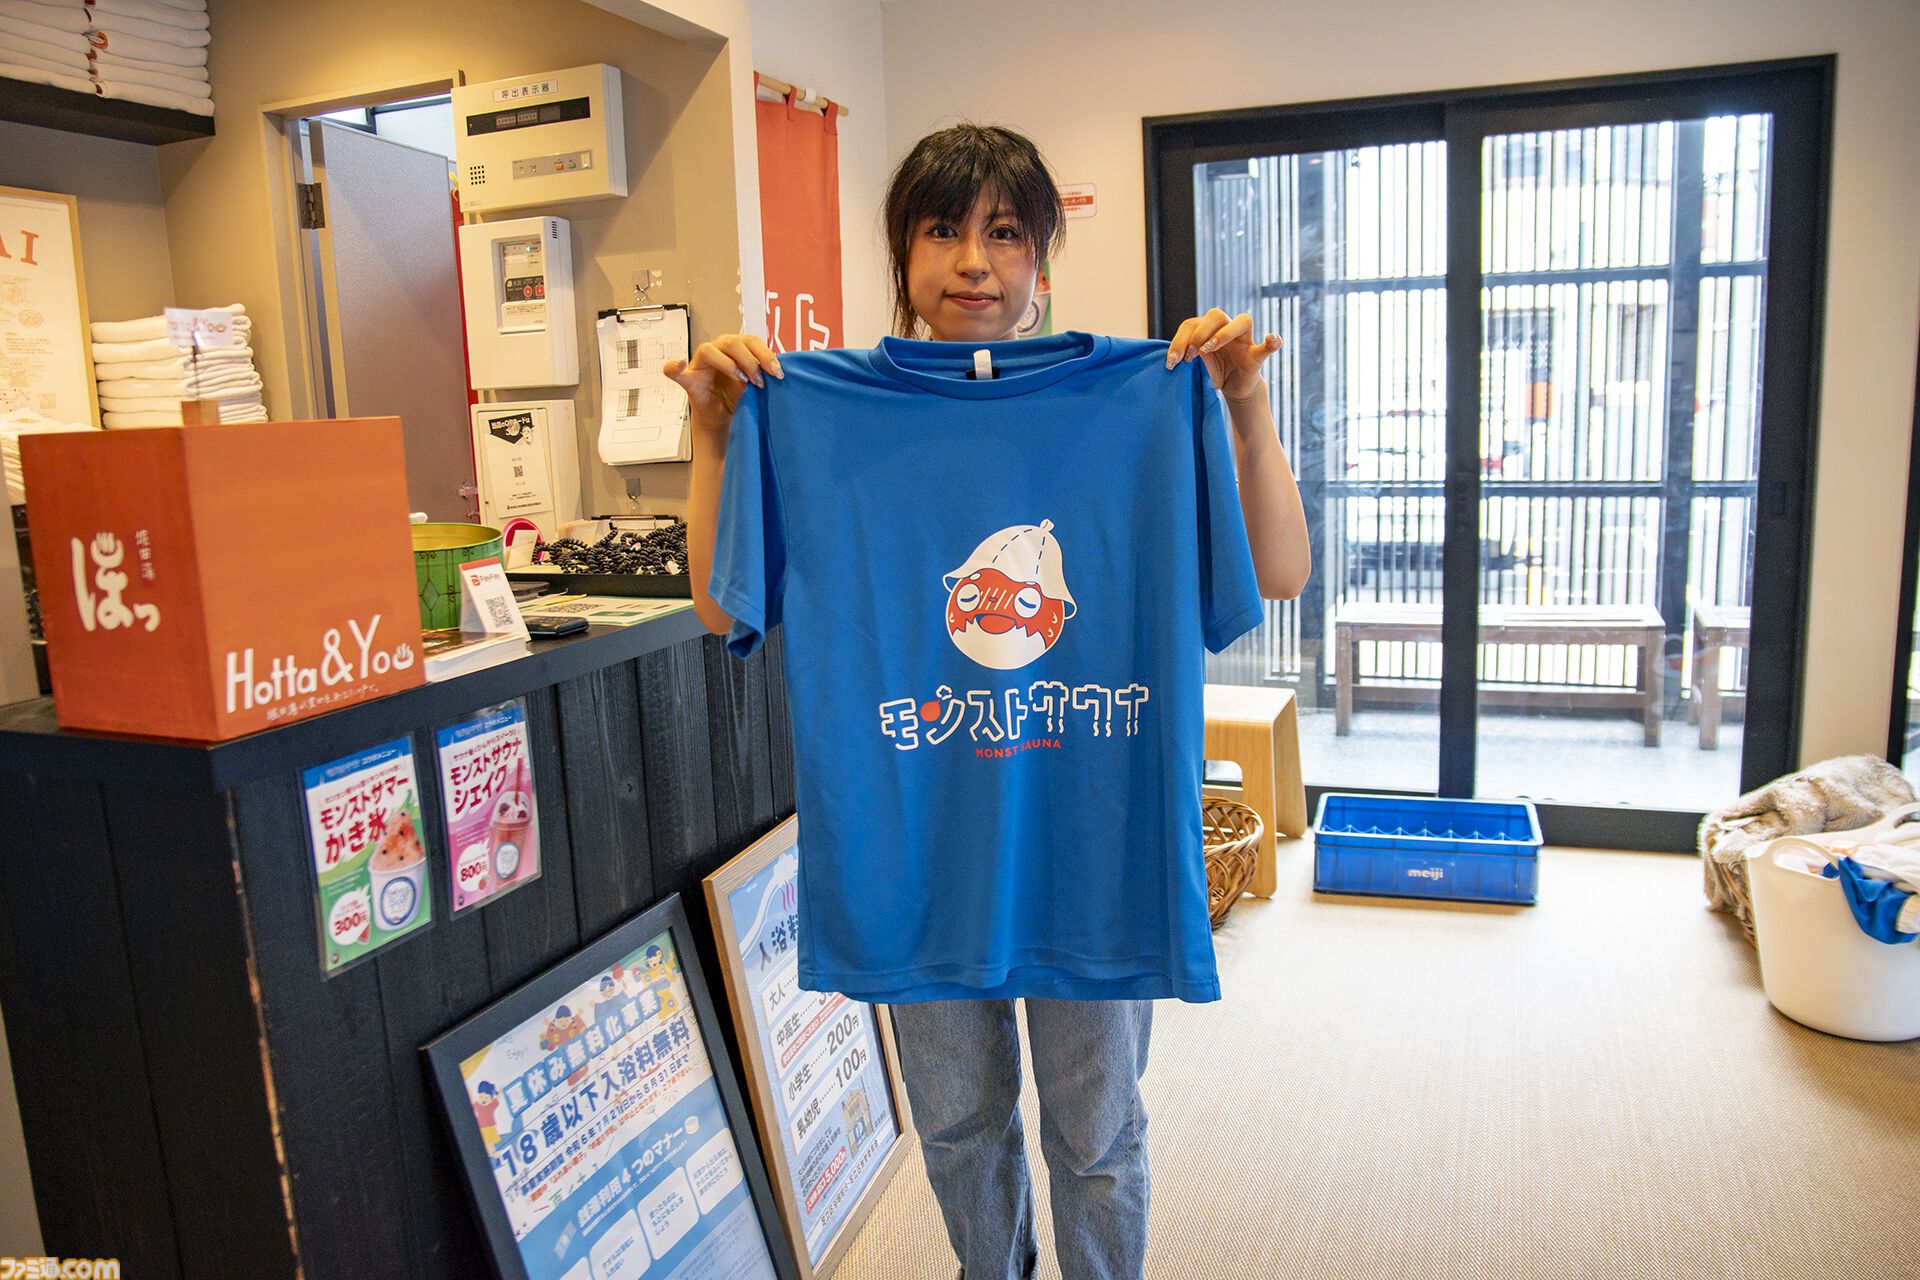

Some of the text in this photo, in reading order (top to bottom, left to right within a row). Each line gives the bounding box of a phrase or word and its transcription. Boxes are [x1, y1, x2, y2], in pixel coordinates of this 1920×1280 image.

[501, 82, 550, 100] 呼出表示器
[451, 738, 522, 786] モンストサウナ
[976, 745, 1018, 759] MONST
[320, 776, 409, 830] モンストサマー
[454, 765, 508, 815] シェイク
[325, 807, 387, 864] かき氷
[1408, 868, 1443, 881] meiji
[769, 982, 786, 1011] 大人
[505, 991, 660, 1113] 夏休み無料化事業
[776, 1012, 802, 1047] 中高生
[788, 1059, 812, 1101] 小学生
[827, 1013, 860, 1056] 200円
[501, 1015, 690, 1176] 18歳以下入浴料無料
[797, 1097, 821, 1139] 乳幼児
[835, 1048, 867, 1089] 100円
